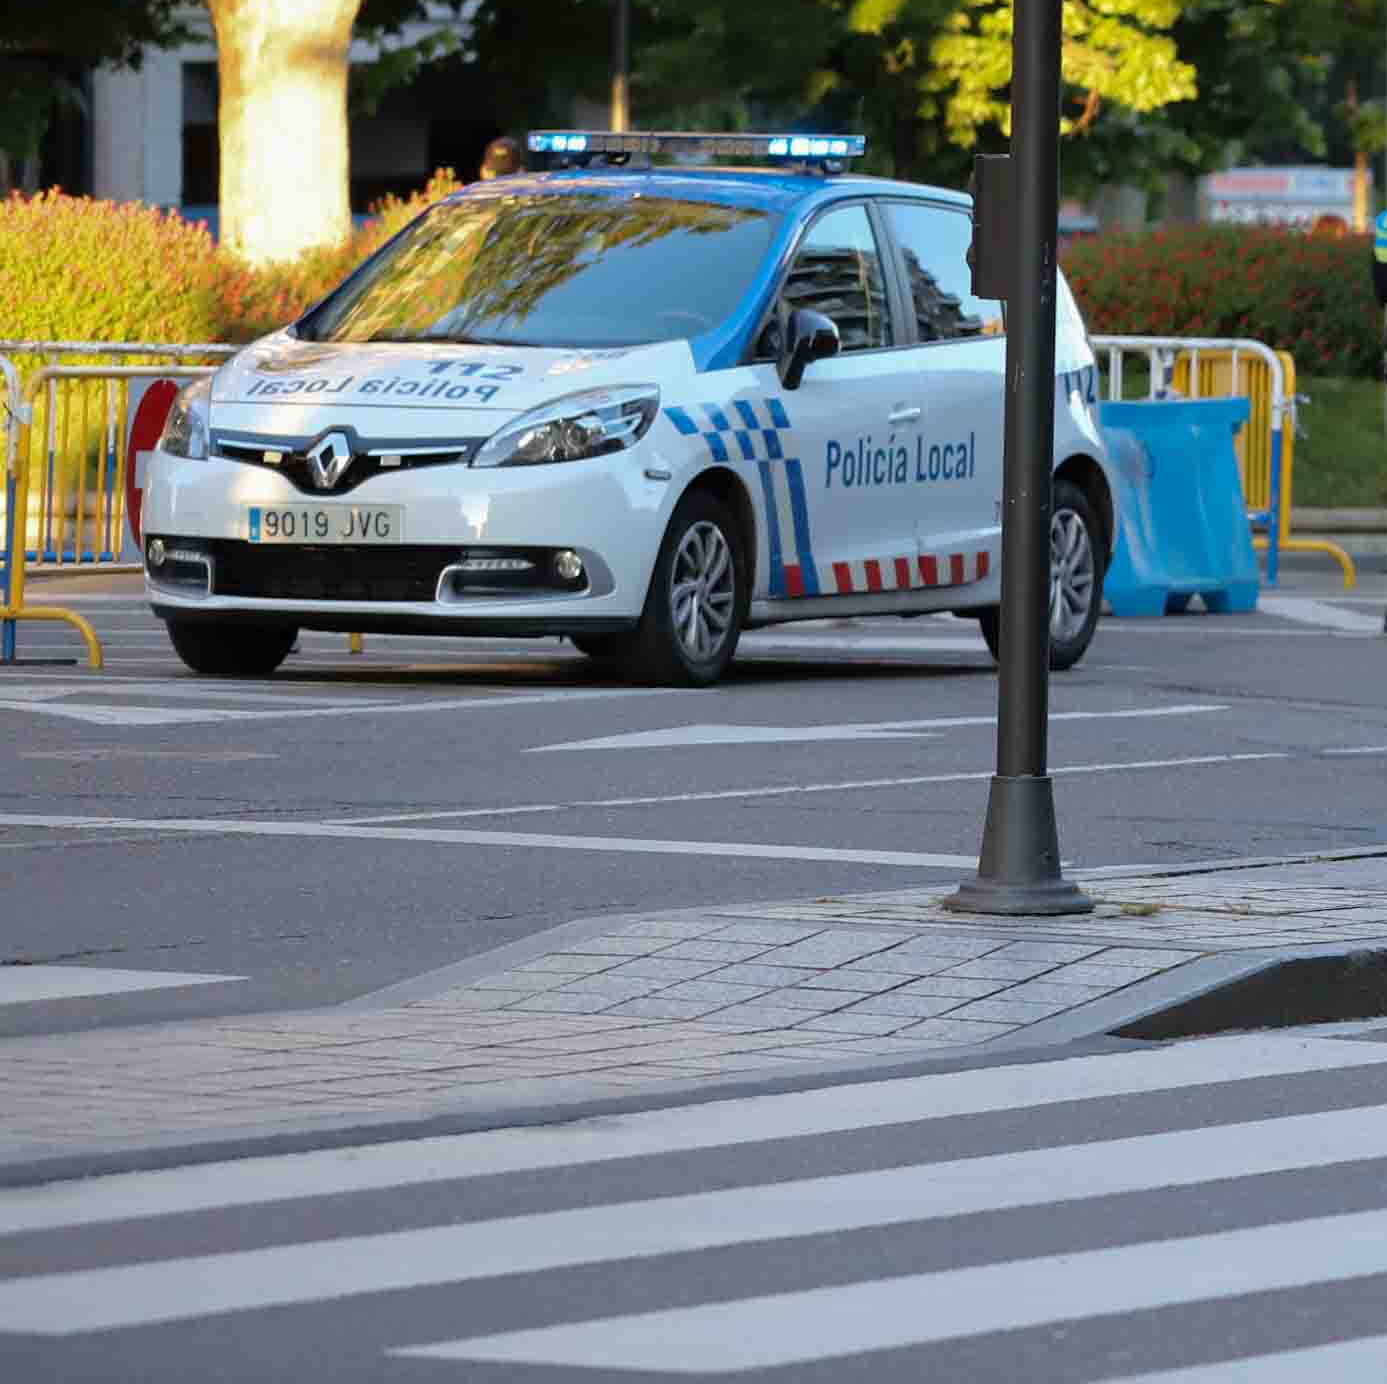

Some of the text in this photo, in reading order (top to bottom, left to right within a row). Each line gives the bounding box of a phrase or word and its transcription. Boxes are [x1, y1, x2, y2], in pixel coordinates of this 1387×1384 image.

[426, 359, 524, 381] 112
[825, 431, 975, 488] Policía Local
[265, 511, 391, 538] 9019 JVG
